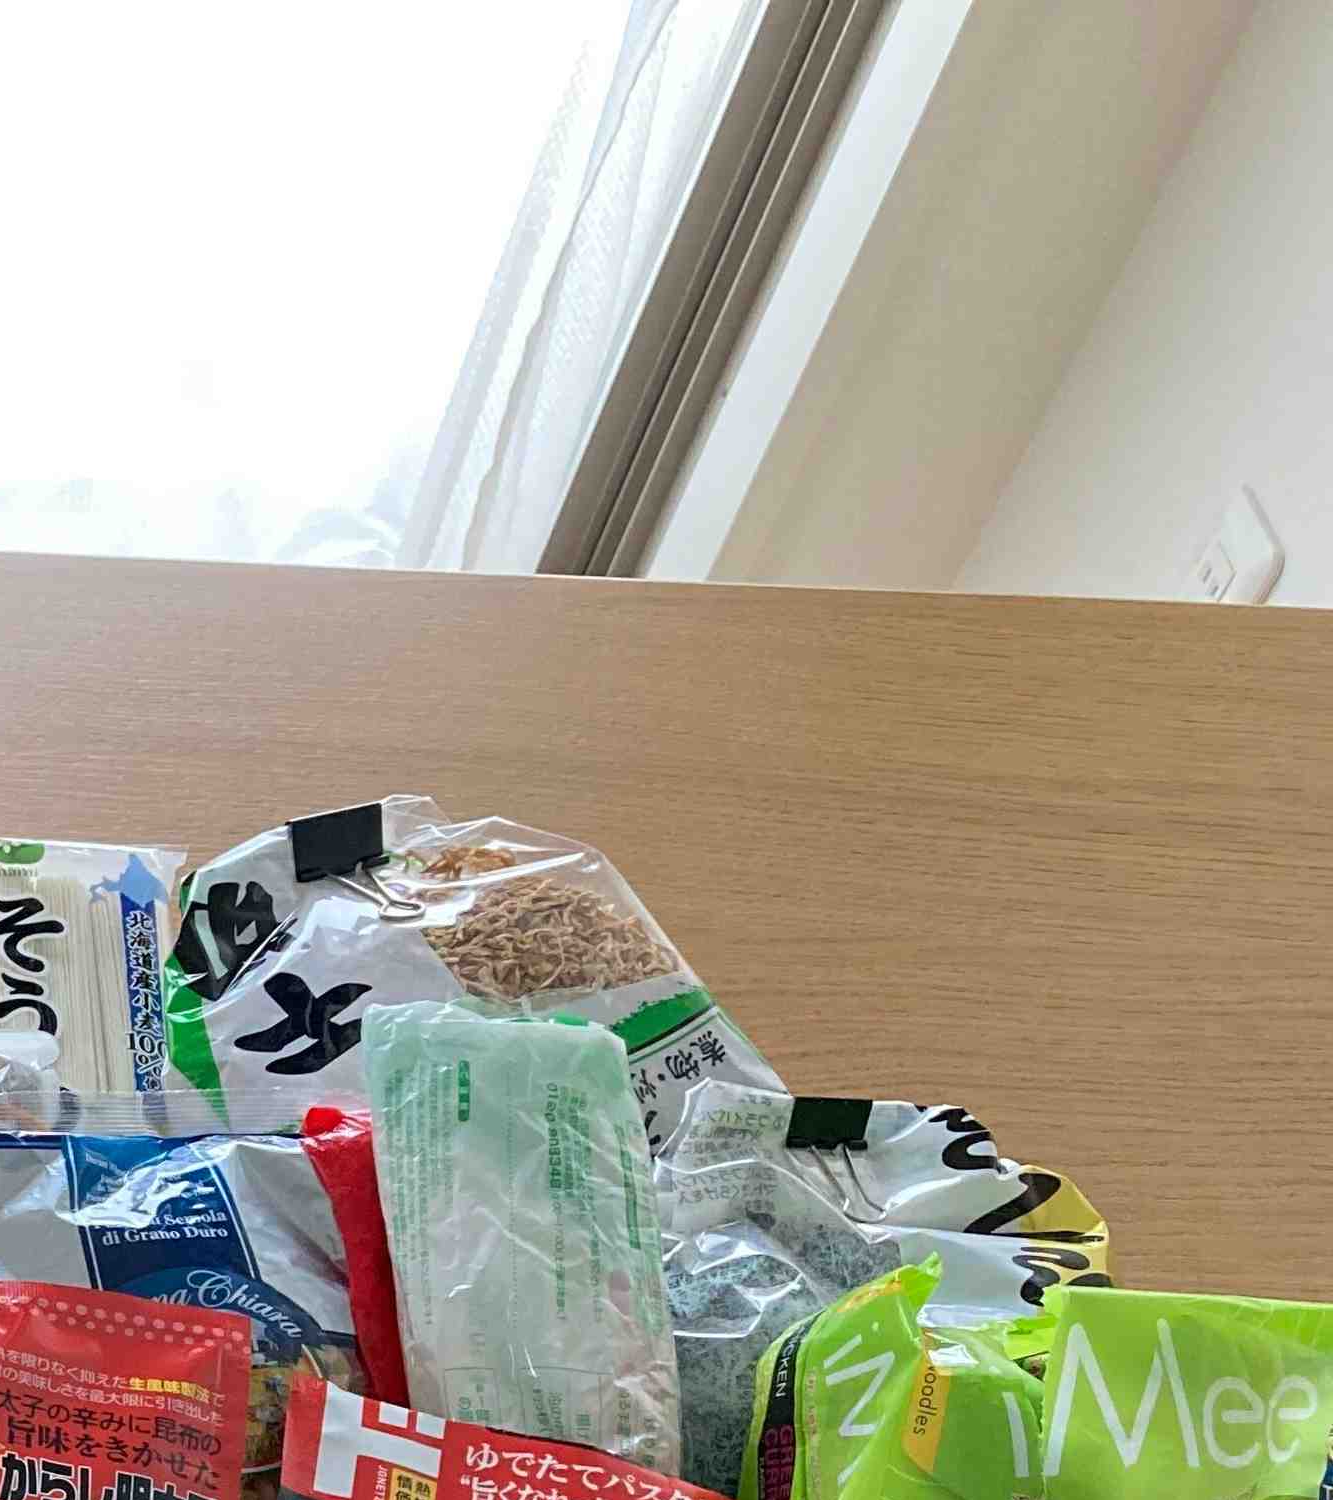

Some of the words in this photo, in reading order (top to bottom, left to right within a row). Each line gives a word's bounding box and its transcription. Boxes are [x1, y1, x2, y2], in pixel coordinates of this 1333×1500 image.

[101, 1227, 122, 1246] di
[124, 1226, 181, 1242] Grano
[184, 1224, 229, 1241] Duro
[6, 1417, 220, 1491] 旨味をきかせた
[397, 1473, 434, 1500] 情熱
